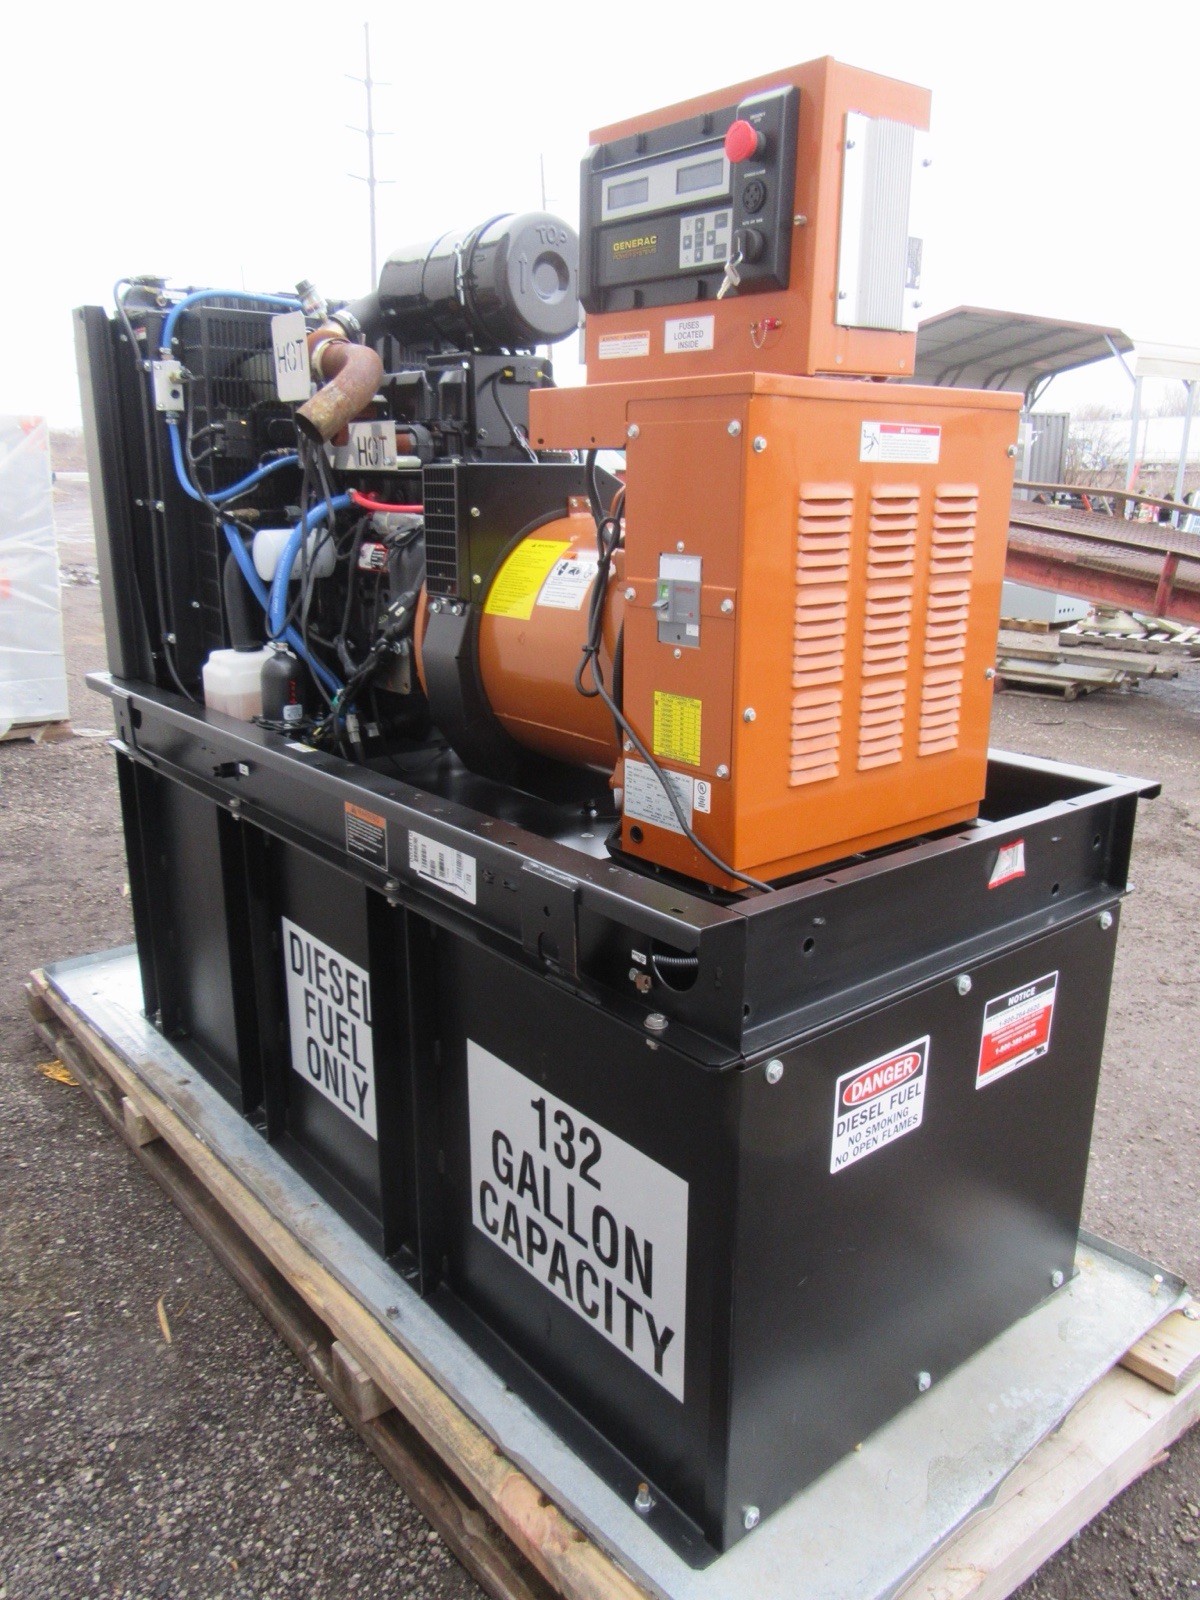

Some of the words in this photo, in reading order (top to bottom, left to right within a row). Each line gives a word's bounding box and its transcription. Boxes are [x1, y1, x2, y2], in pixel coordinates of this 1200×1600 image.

[612, 235, 658, 252] GENERAC
[673, 330, 704, 340] LOCATED
[677, 340, 699, 349] INSIDE
[679, 320, 700, 330] FUSES
[275, 339, 304, 374] HOT
[356, 435, 388, 466] HOT
[289, 930, 372, 1028] DIESEL
[1007, 986, 1037, 1006] NOTICE
[304, 986, 367, 1073] FUEL
[306, 1036, 369, 1120] ONLY
[851, 1056, 915, 1102] DANGER
[836, 1101, 884, 1138] DIESEL
[889, 1082, 922, 1110] FUEL
[847, 1132, 862, 1147] NO
[865, 1106, 909, 1138] SMOKING
[530, 1096, 603, 1192] 132
[834, 1153, 849, 1167] NO
[852, 1137, 878, 1157] OPEN
[881, 1113, 918, 1142] FLAMES
[491, 1129, 654, 1300] GALLON
[479, 1179, 675, 1378] CAPACITY
